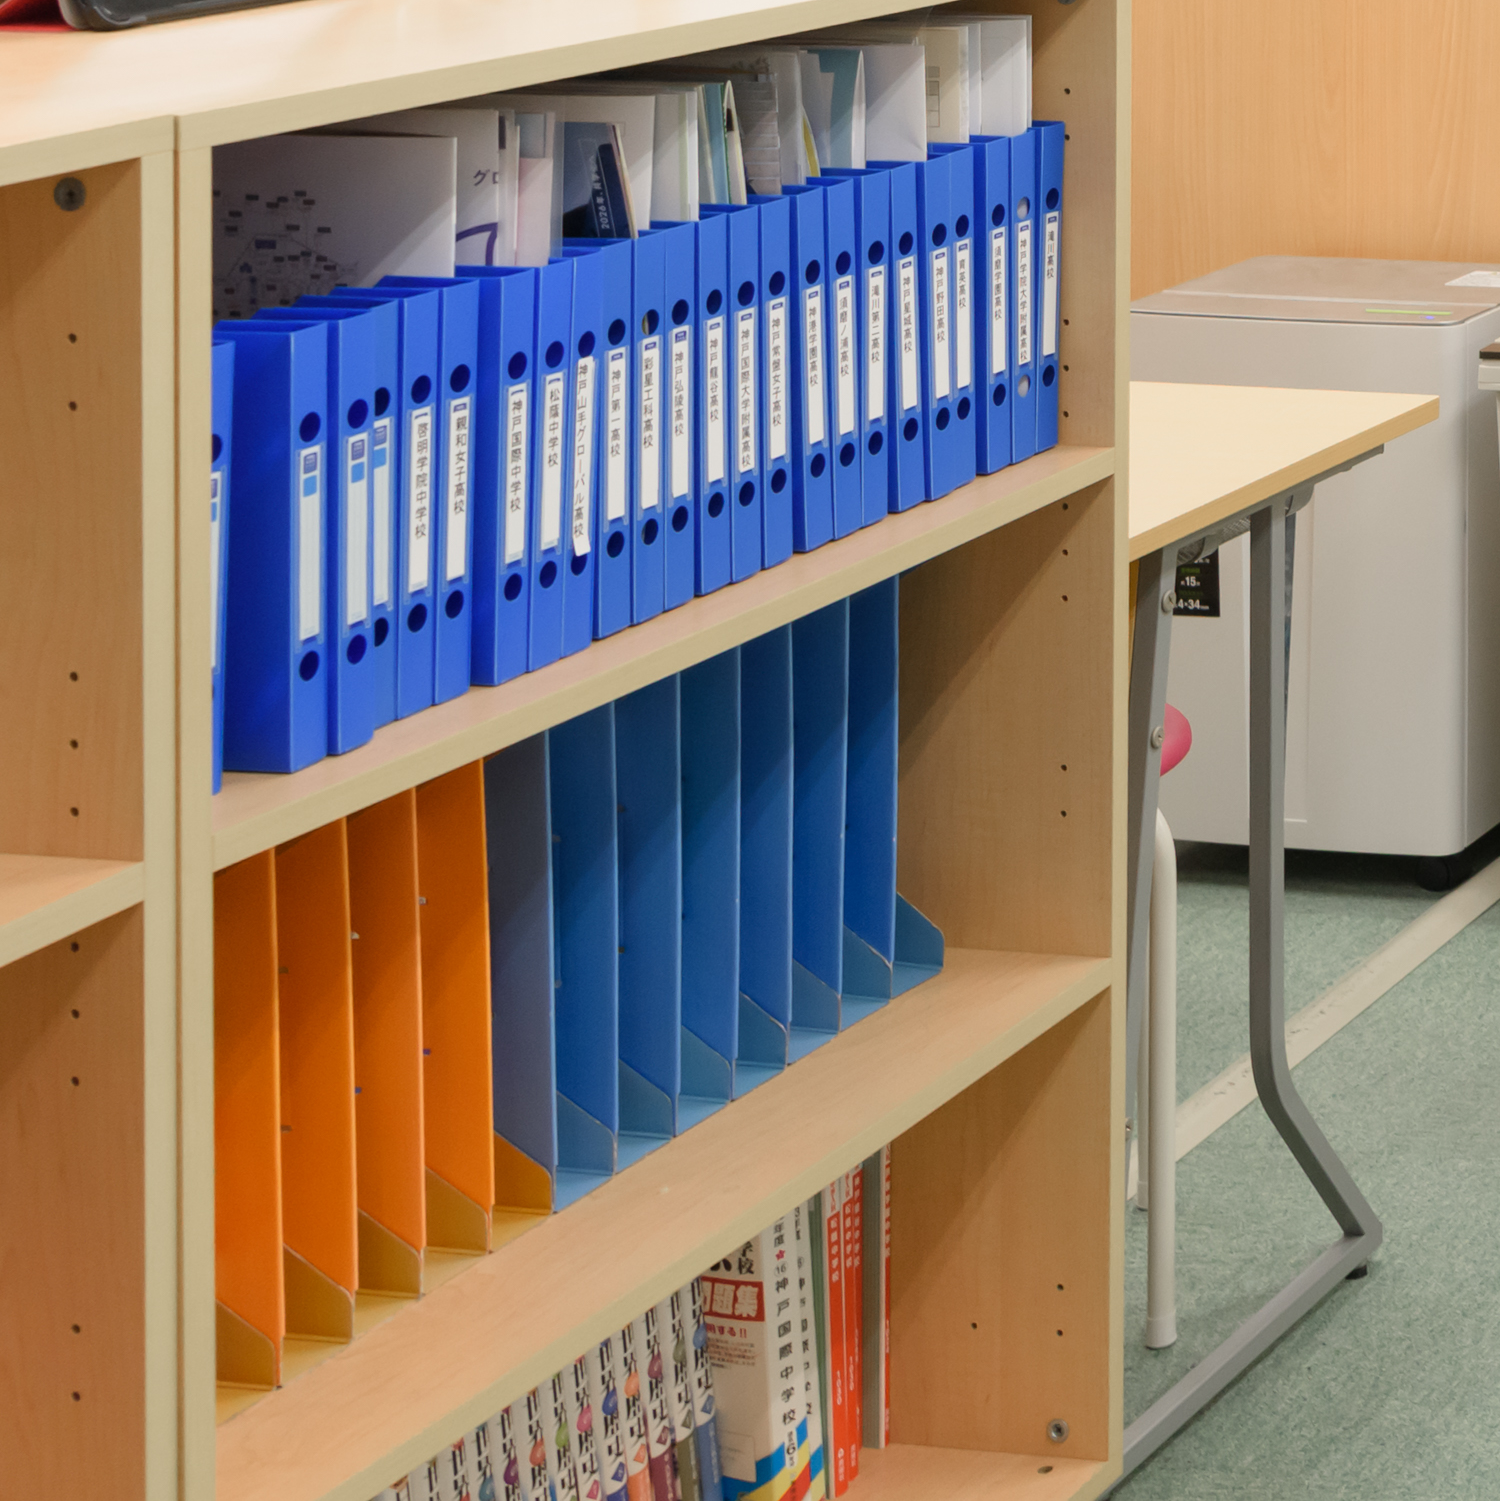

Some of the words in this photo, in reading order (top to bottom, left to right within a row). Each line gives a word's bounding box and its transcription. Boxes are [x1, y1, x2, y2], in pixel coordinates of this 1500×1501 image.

[1047, 230, 1055, 280] 滝川高校
[808, 306, 818, 387] 神港学園高校
[871, 285, 880, 363] 滝川第二高校
[935, 266, 945, 343] 神戸野田高校
[610, 369, 622, 457] 神戸第一高校
[643, 357, 653, 449] 彩星工科高校
[674, 352, 684, 437] 神戸弘陵高校
[415, 423, 428, 540] 啓明学院中学校
[453, 416, 467, 515] 親和女子高校
[510, 400, 523, 513] 神戸国際中学校
[573, 364, 588, 538] 神戸山手グローバル高校
[775, 1277, 797, 1426] 神戸国際中学校
